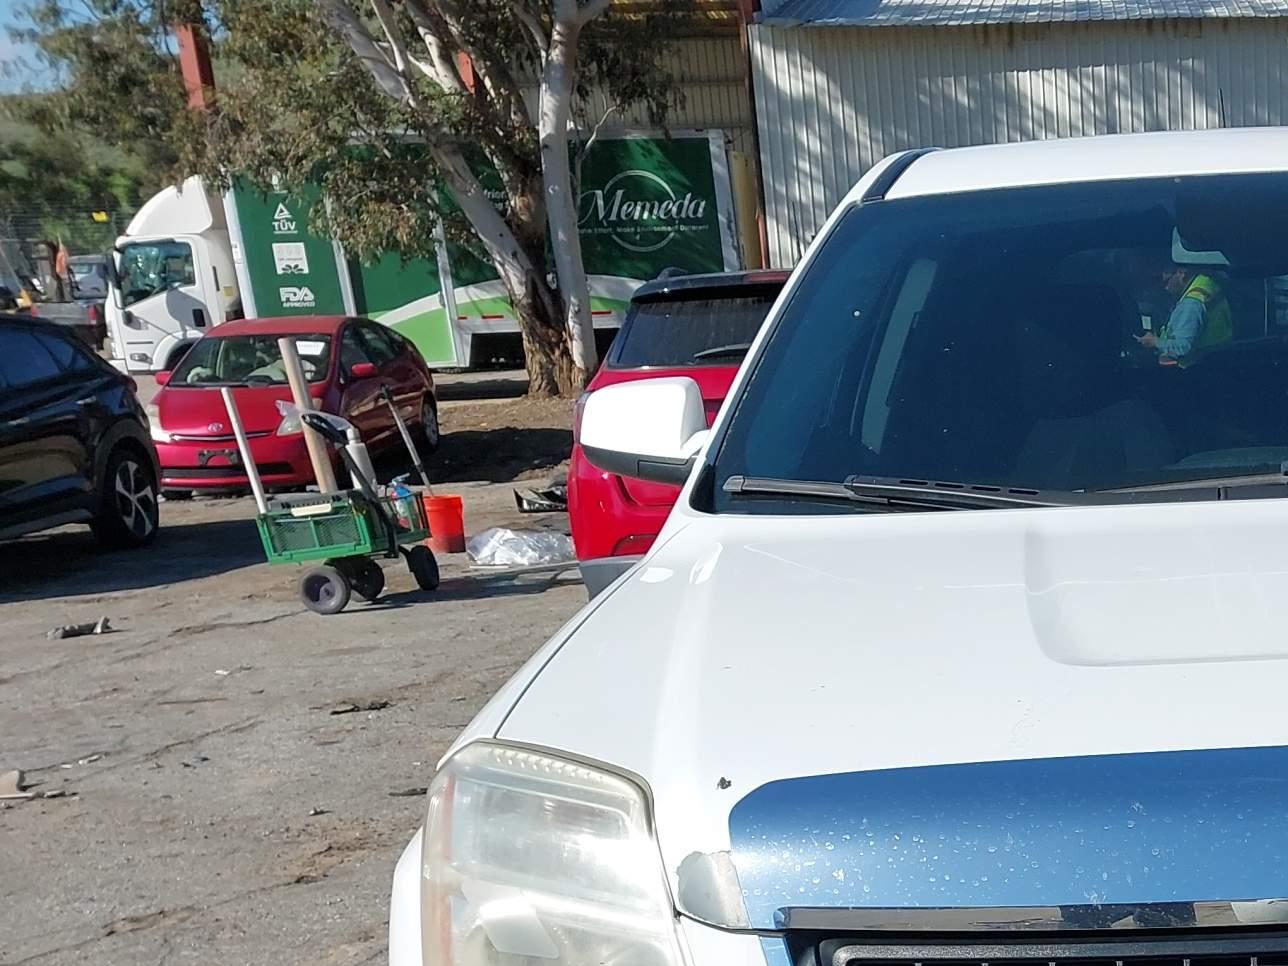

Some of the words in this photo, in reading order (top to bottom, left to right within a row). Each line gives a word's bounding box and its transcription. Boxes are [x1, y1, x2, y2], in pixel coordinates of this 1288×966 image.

[577, 189, 706, 226] Memeda
[272, 219, 296, 231] TÜV
[279, 287, 315, 302] FDA
